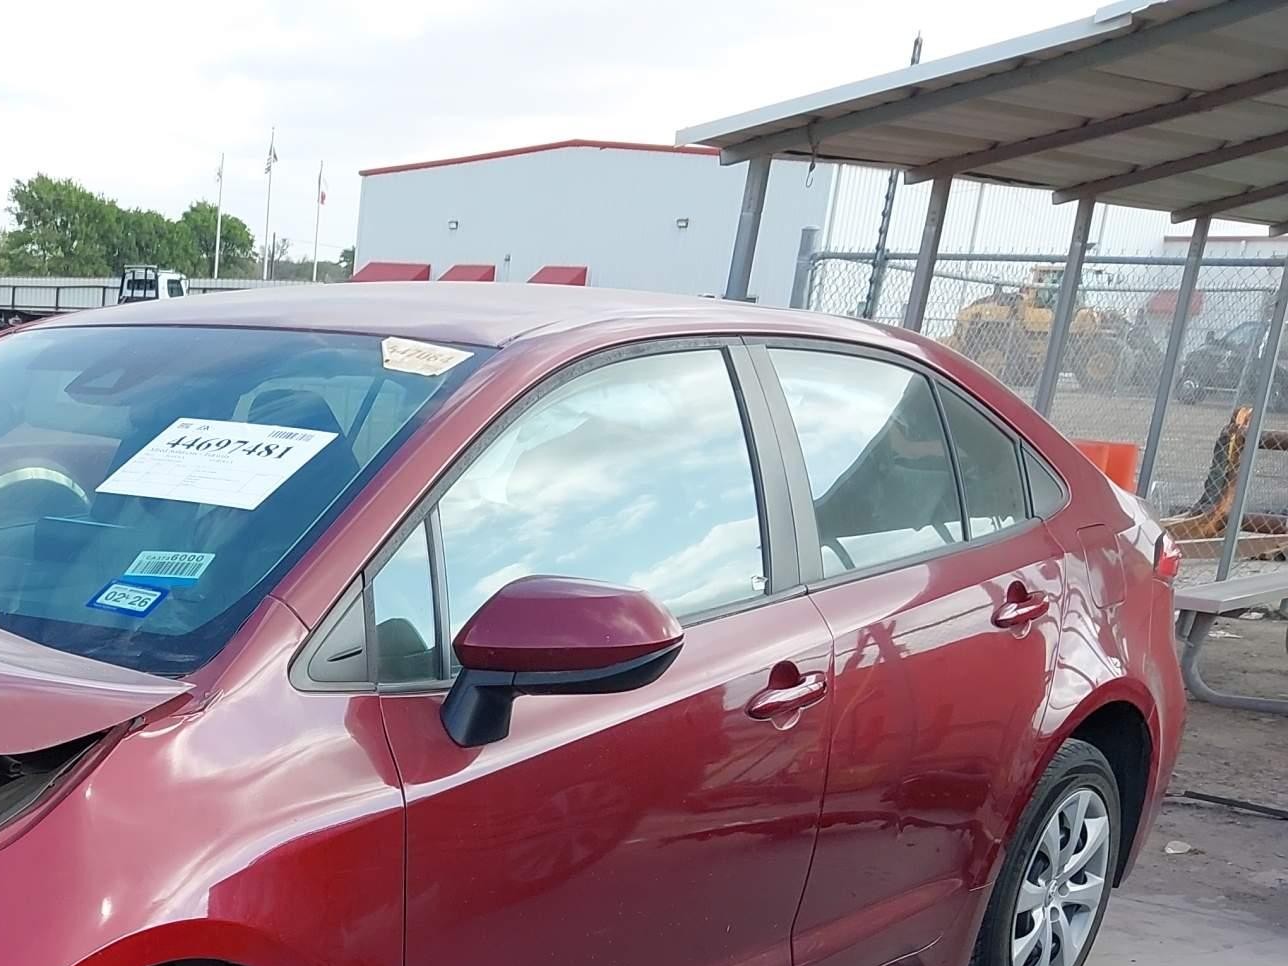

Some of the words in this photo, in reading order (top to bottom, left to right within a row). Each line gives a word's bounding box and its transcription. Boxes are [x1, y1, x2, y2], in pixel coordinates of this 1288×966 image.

[166, 435, 295, 460] 44697481
[104, 591, 126, 603] 02
[128, 595, 152, 608] 26
